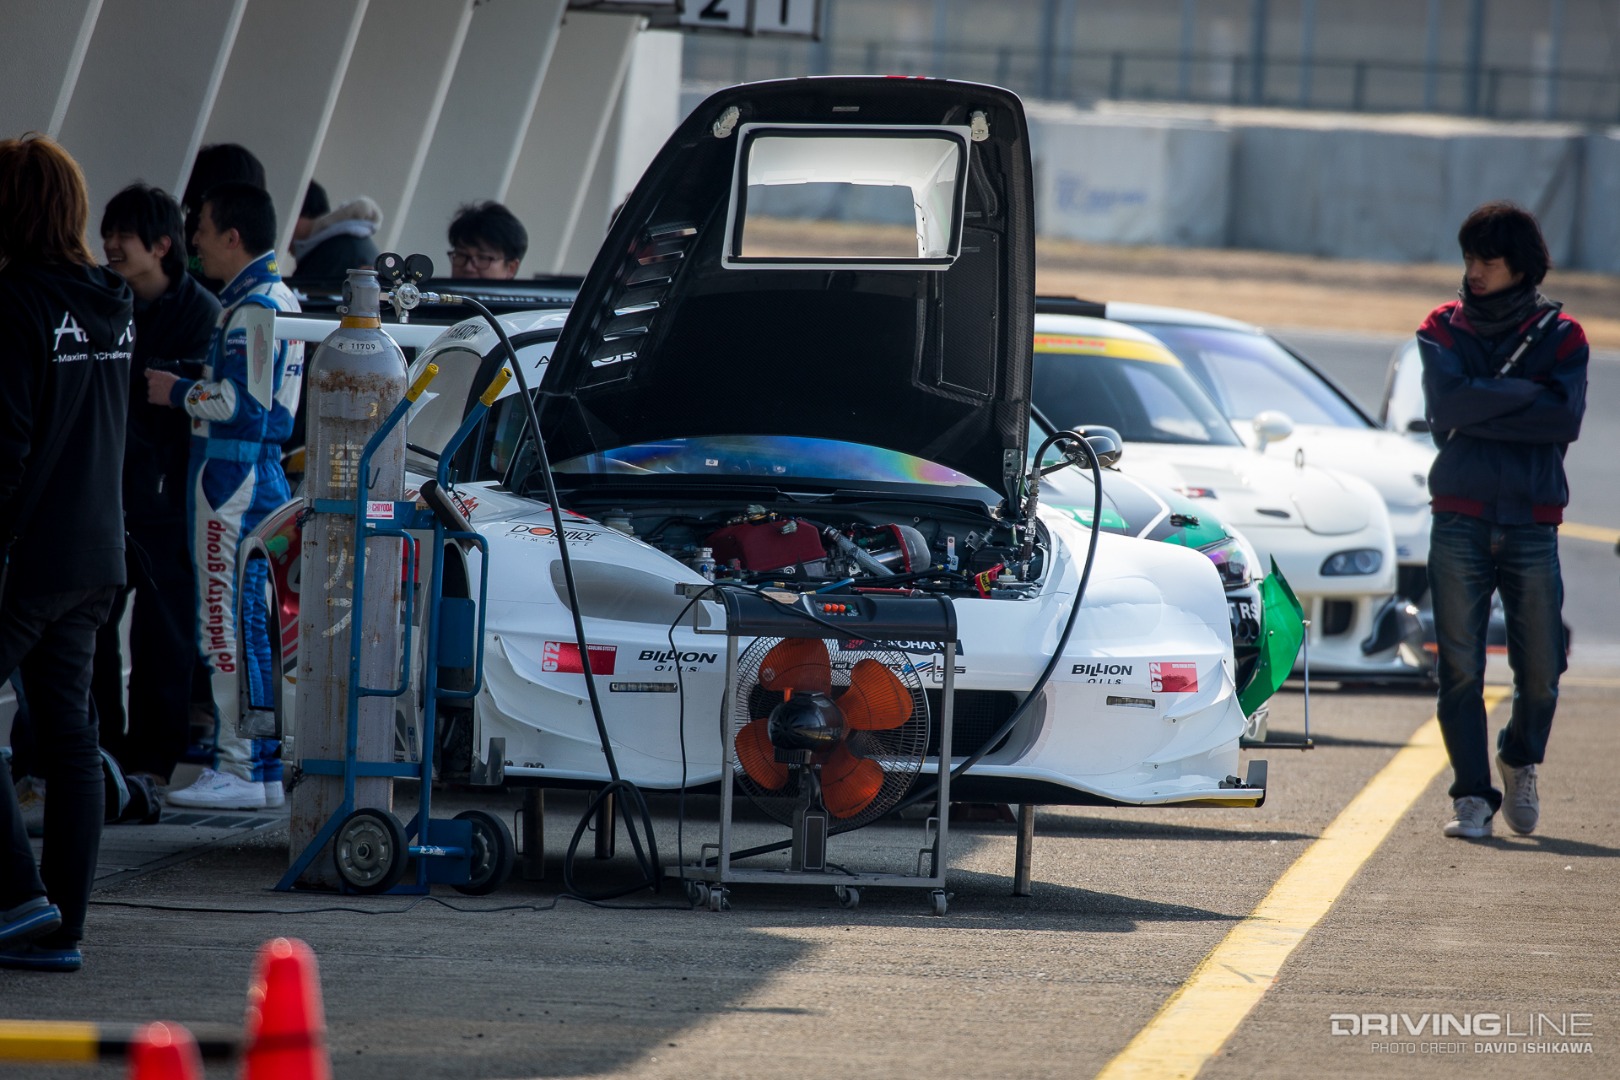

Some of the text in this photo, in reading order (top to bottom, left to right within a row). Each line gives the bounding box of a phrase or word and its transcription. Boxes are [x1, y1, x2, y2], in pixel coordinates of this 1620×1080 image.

[206, 520, 235, 673] do industry group
[1239, 602, 1258, 619] RS
[638, 650, 718, 663] BILLION
[1071, 663, 1133, 677] BILLION
